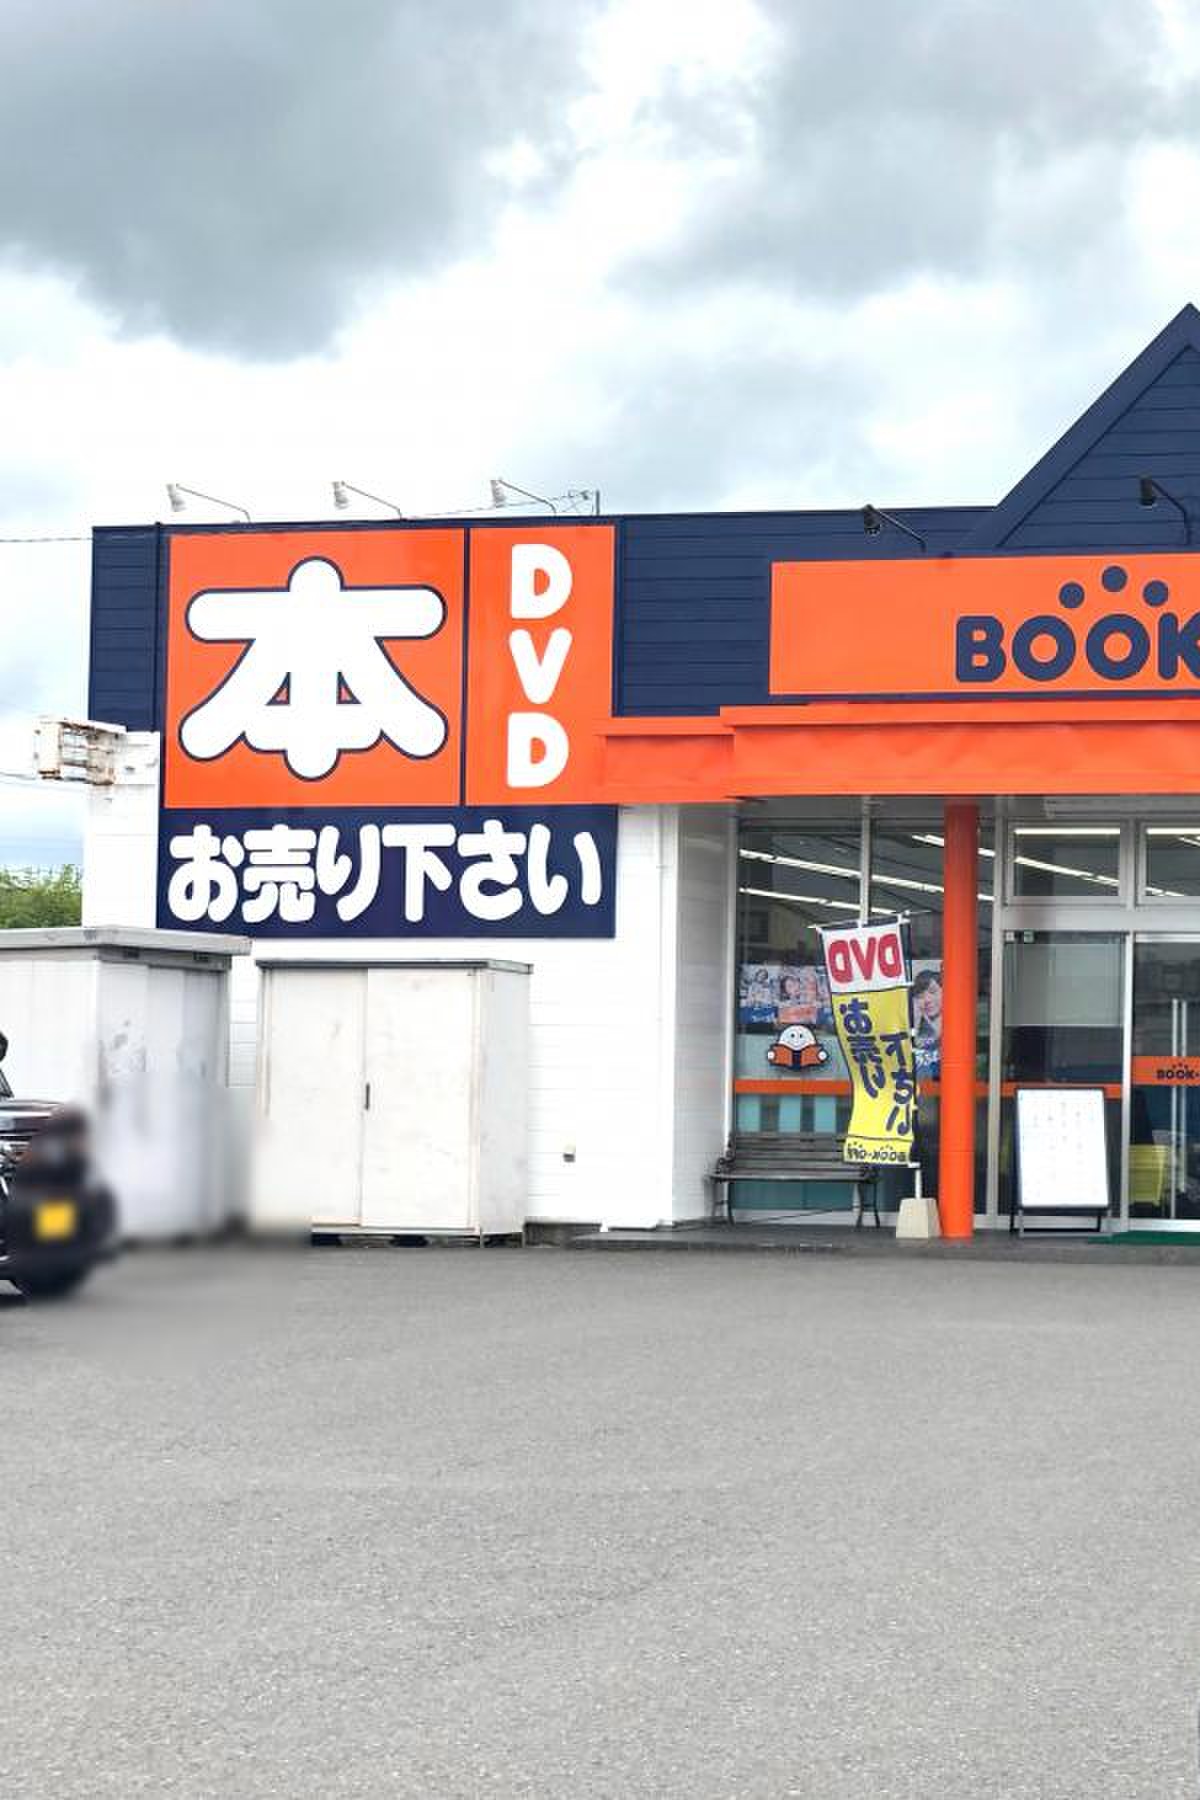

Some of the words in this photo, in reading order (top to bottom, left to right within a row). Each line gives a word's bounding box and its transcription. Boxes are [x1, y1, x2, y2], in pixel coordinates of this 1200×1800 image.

[180, 557, 448, 780] 本
[507, 543, 573, 788] DVD
[167, 820, 602, 923] お売り下さい
